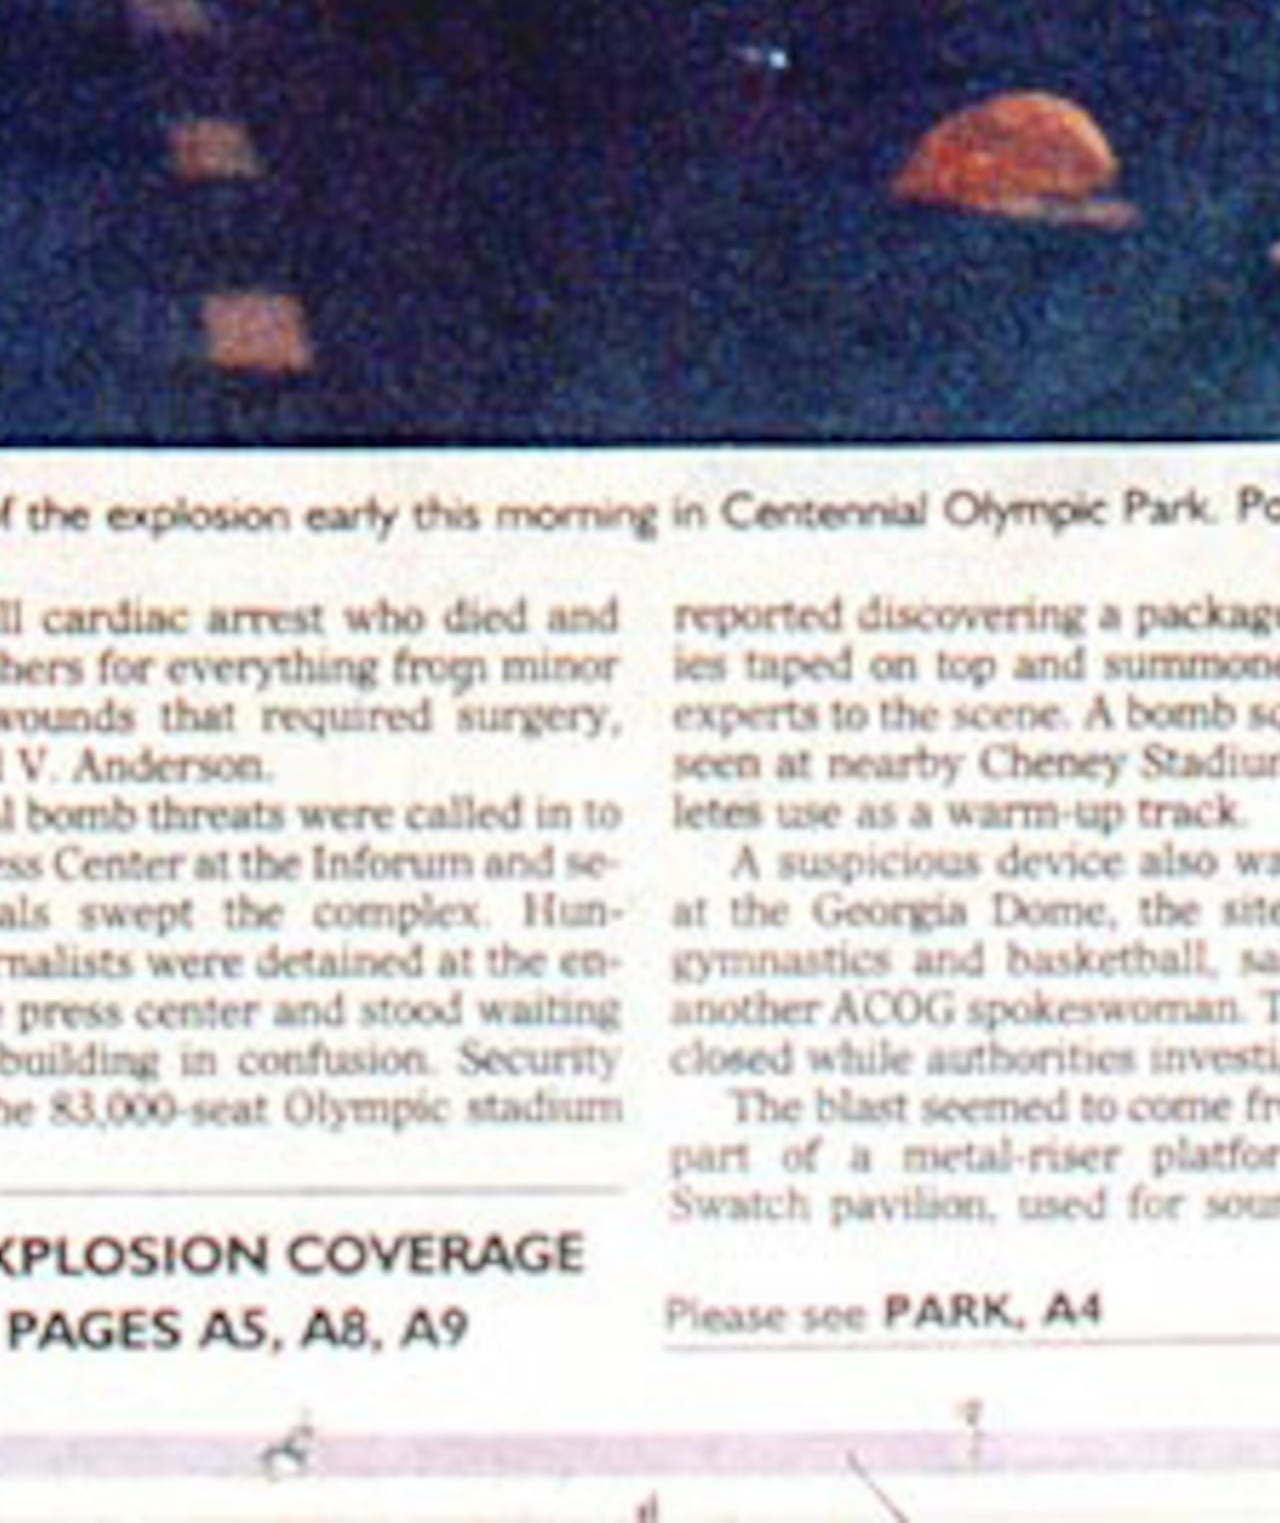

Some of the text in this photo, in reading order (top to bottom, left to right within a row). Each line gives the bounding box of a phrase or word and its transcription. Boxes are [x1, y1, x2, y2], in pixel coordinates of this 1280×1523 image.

[27, 497, 90, 531] the
[106, 498, 289, 536] explosion
[305, 498, 398, 536] early
[413, 498, 480, 531] this
[497, 505, 657, 535] morning
[674, 495, 705, 525] in
[721, 491, 927, 530] Centennial
[944, 490, 1107, 535] Olympic
[1124, 489, 1210, 524] Park.
[675, 596, 843, 639] reported
[858, 594, 1086, 638] discovering
[1099, 605, 1121, 630] a
[287, 1233, 581, 1275] COVERAGE
[9, 1309, 181, 1350] PAGES
[199, 1308, 281, 1352] A5,
[301, 1308, 381, 1350] A8,
[401, 1308, 467, 1347] A9
[668, 1291, 1101, 1331] Please see PARK, A4
